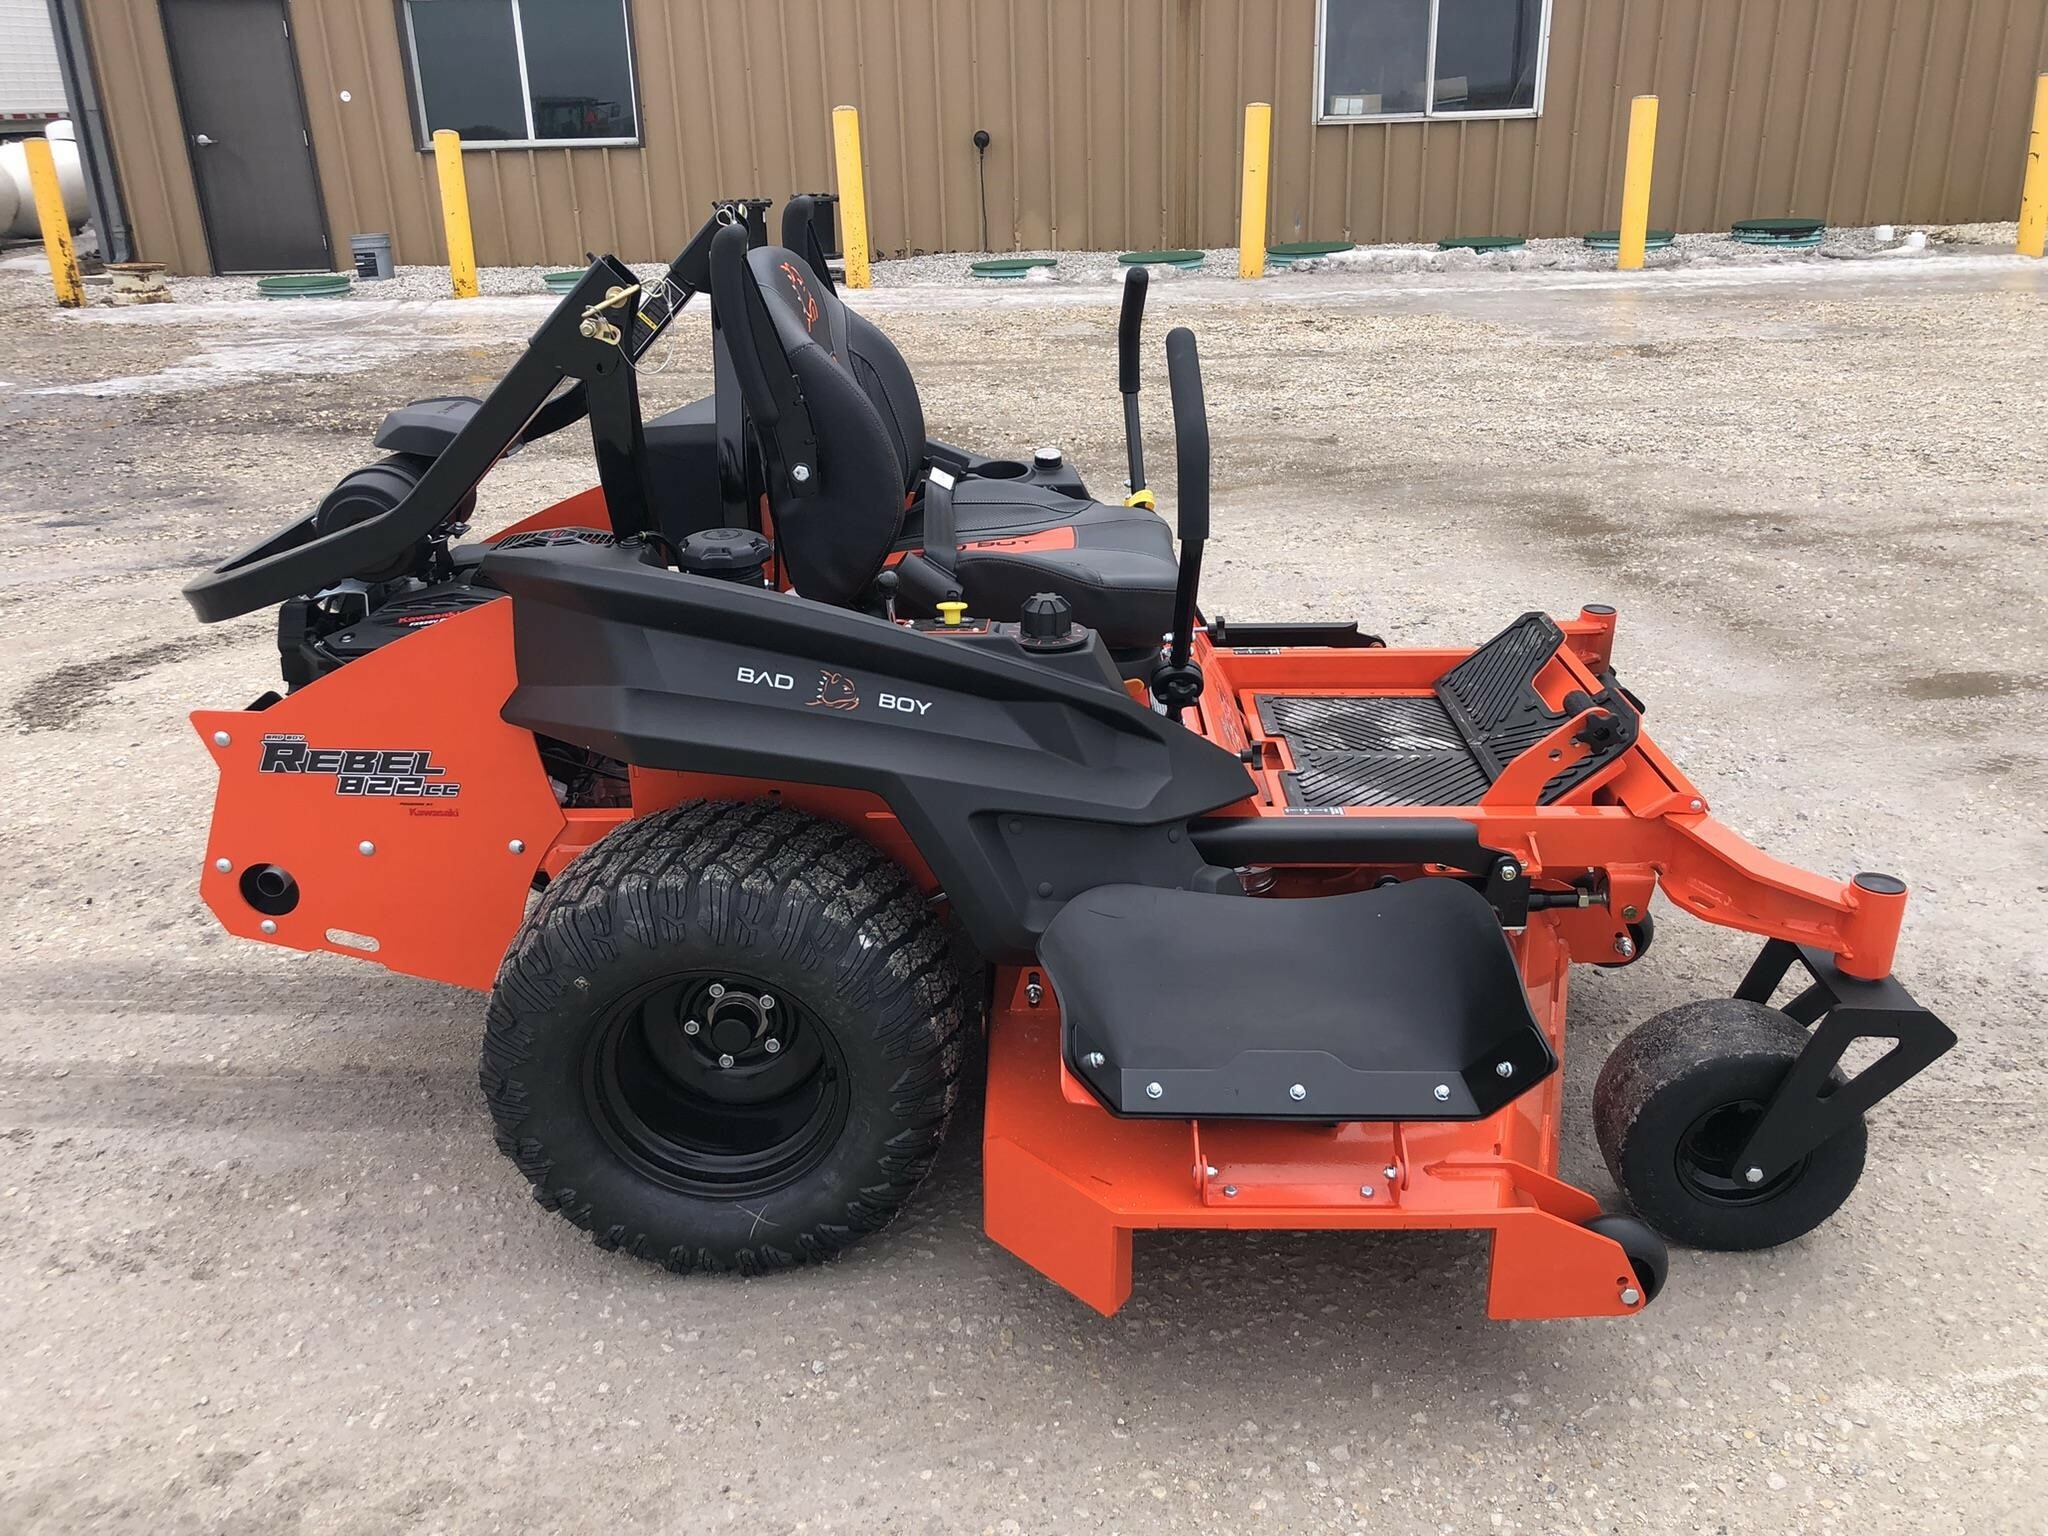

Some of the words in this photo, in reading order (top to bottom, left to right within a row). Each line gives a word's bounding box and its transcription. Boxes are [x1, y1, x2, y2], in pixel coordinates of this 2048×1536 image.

[737, 667, 794, 690] BAD
[879, 693, 933, 715] BOY
[259, 740, 447, 776] REBEL
[408, 807, 459, 817] Kawasaki
